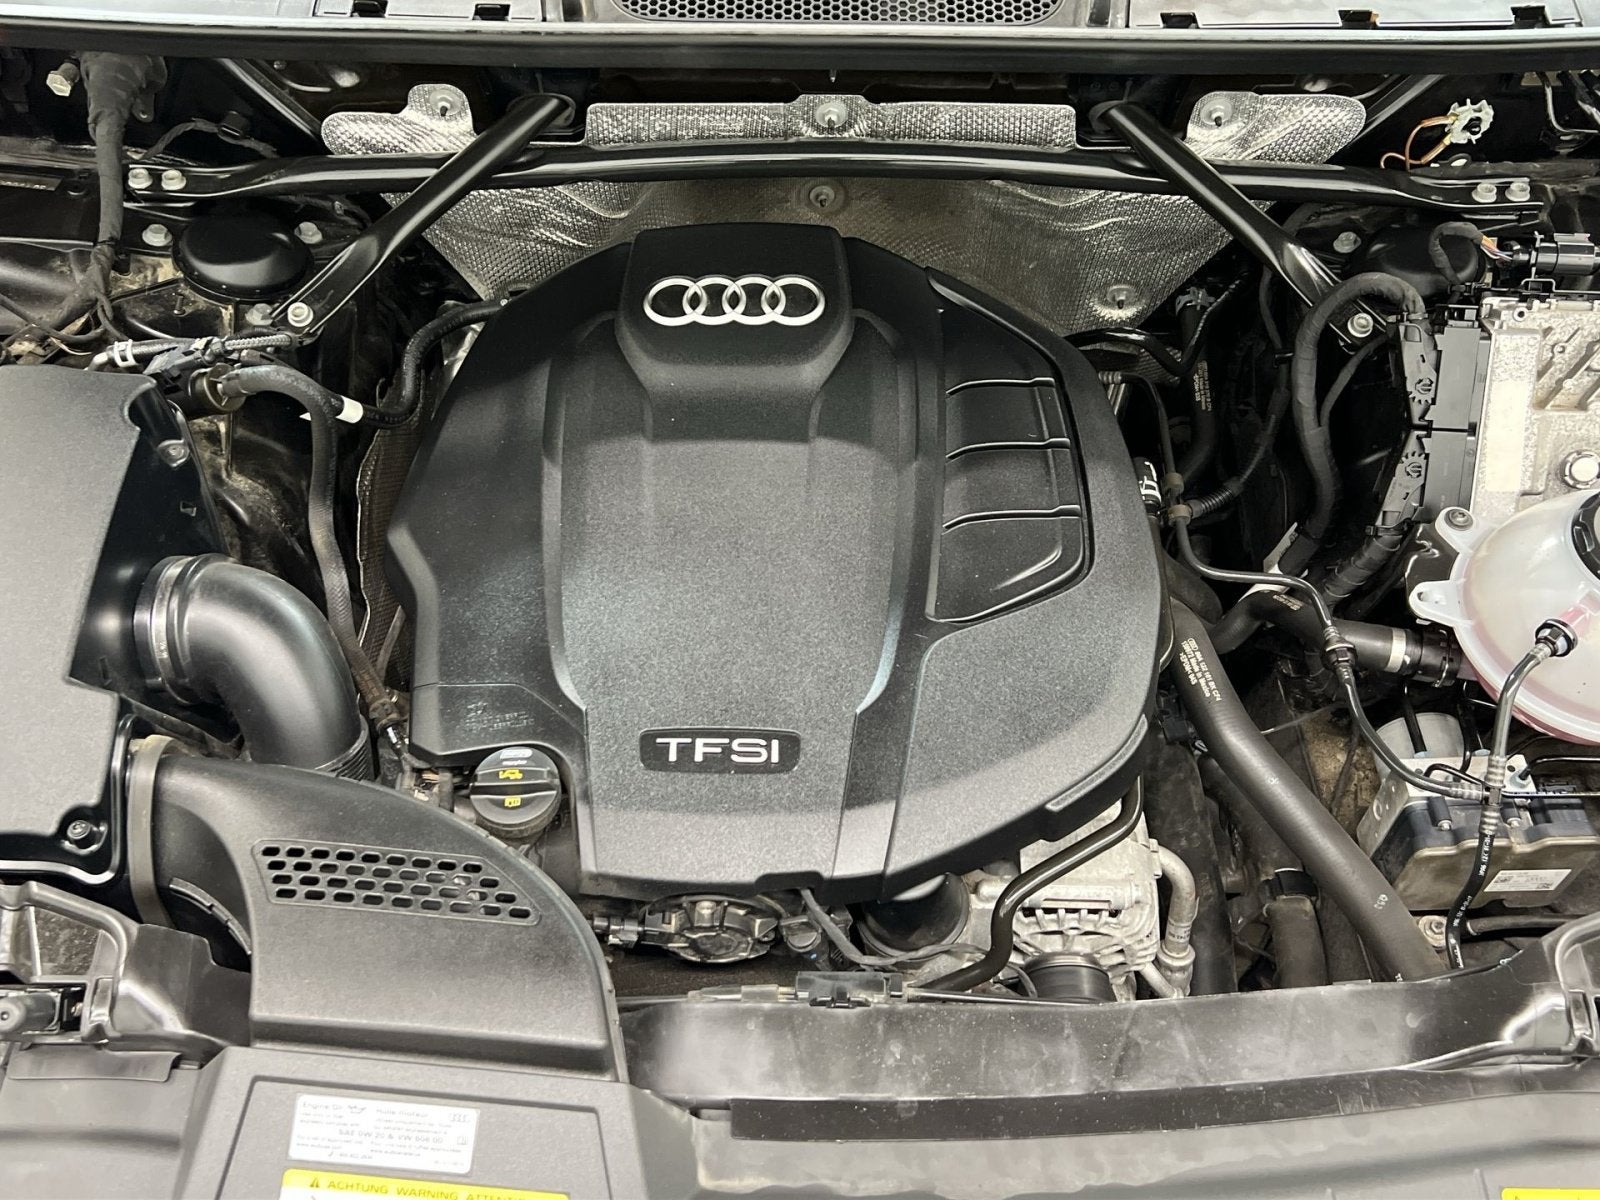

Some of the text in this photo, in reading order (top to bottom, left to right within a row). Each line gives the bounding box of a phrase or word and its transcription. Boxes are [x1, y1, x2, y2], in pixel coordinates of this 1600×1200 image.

[1189, 657, 1200, 672] Made
[1196, 671, 1203, 679] in
[1199, 677, 1211, 697] Mexico
[655, 737, 780, 763] TFSI
[302, 1101, 329, 1111] Engine
[399, 1109, 429, 1119] moteur
[338, 1129, 355, 1137] SAE
[327, 1180, 389, 1194] ACHTUNG
[396, 1187, 458, 1200] WARNING
